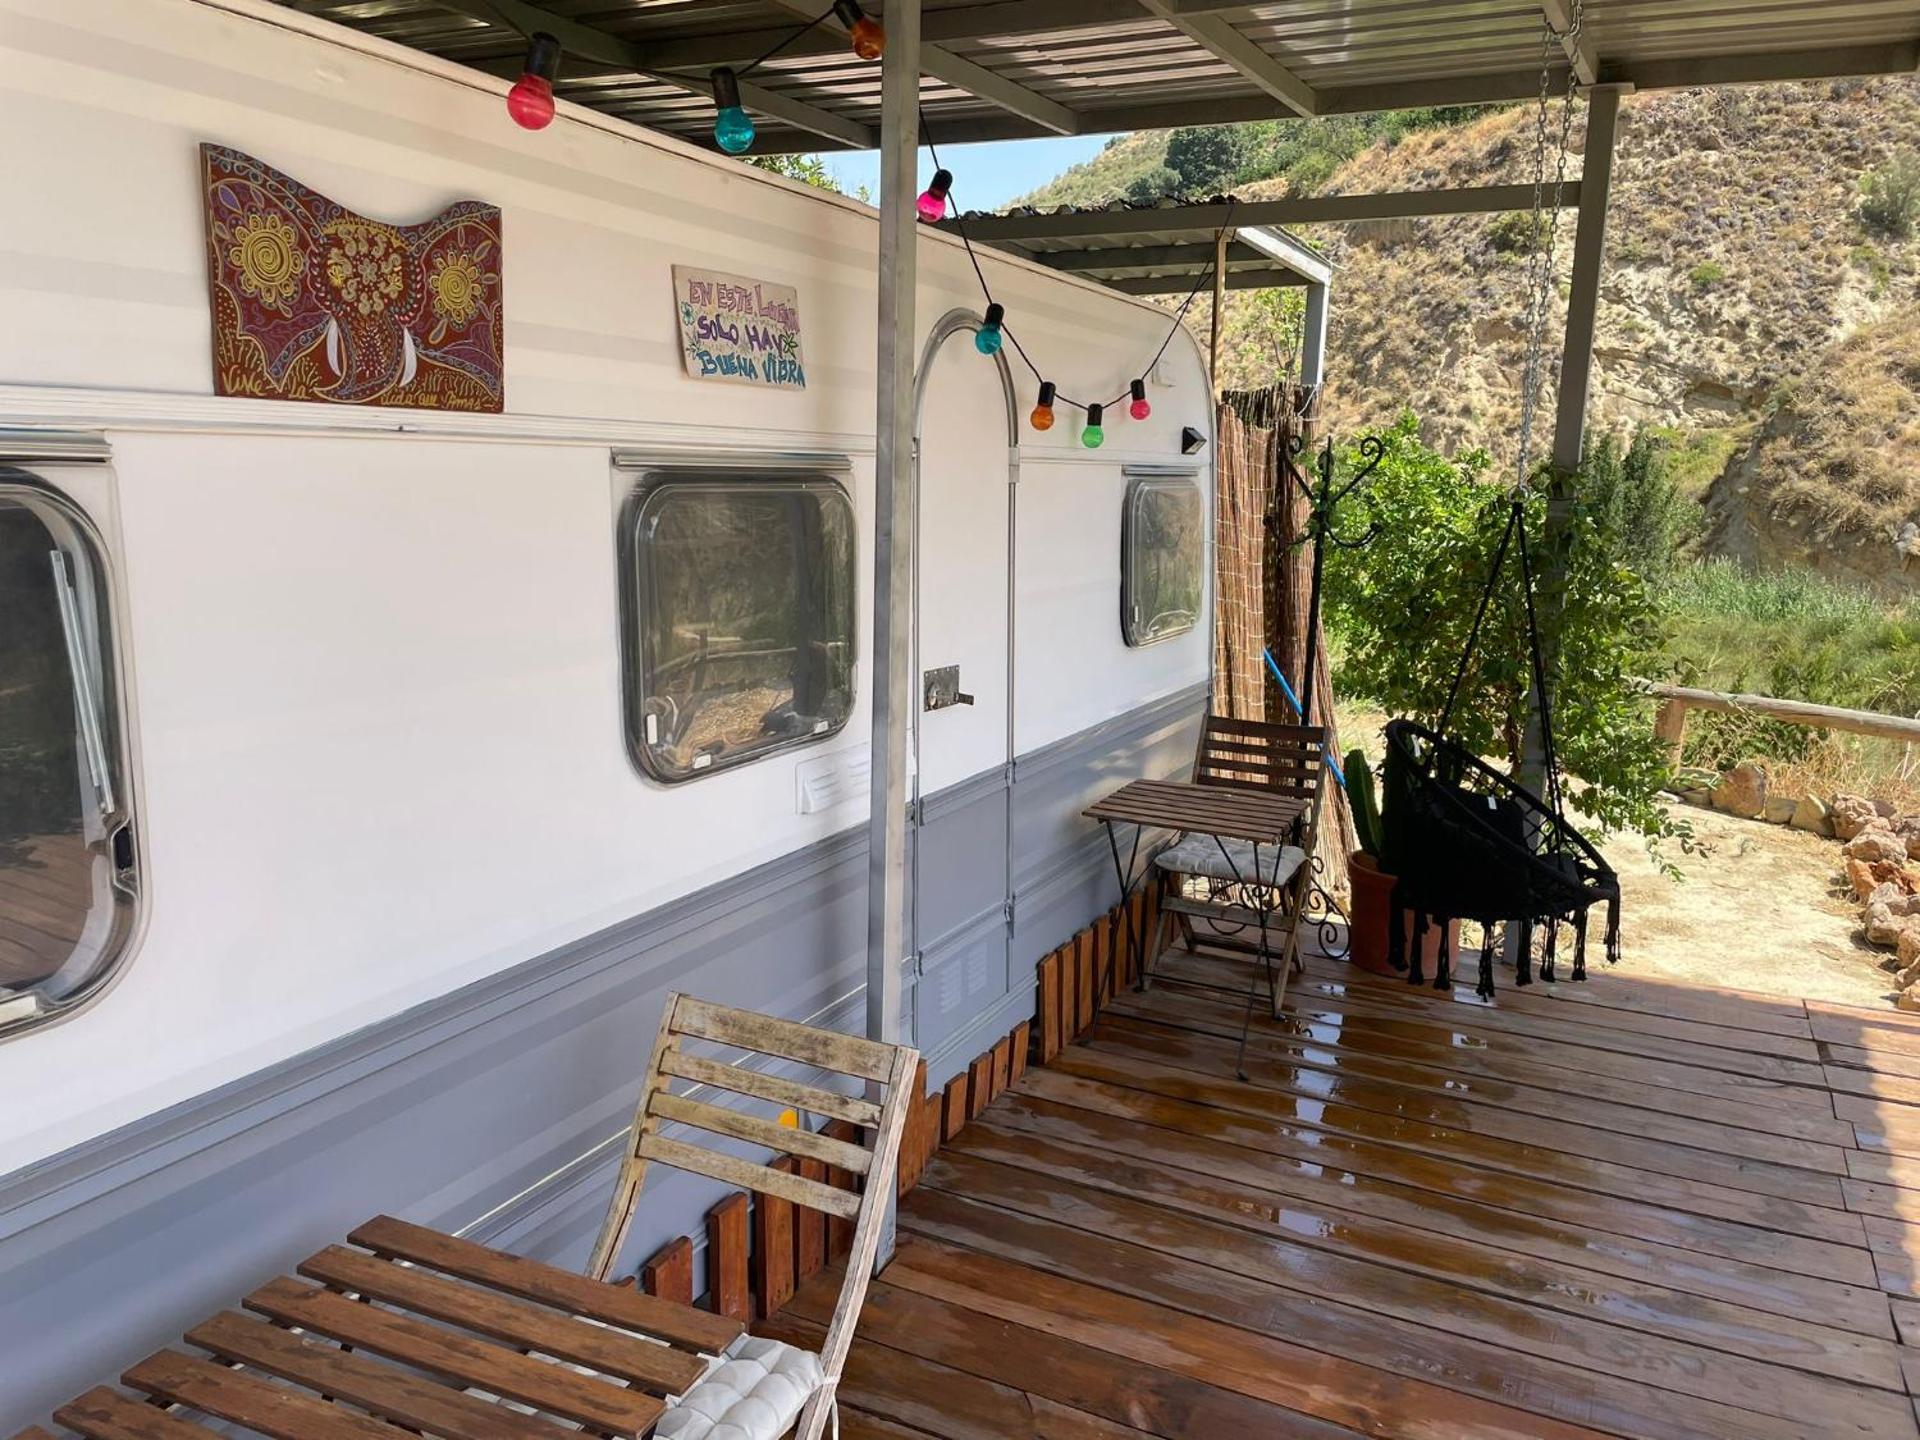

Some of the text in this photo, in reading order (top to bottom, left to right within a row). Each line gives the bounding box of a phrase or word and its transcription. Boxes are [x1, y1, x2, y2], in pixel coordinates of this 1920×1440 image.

[688, 279, 713, 306] EN
[697, 314, 784, 359] SOLO HAY
[696, 350, 758, 380] BUENA
